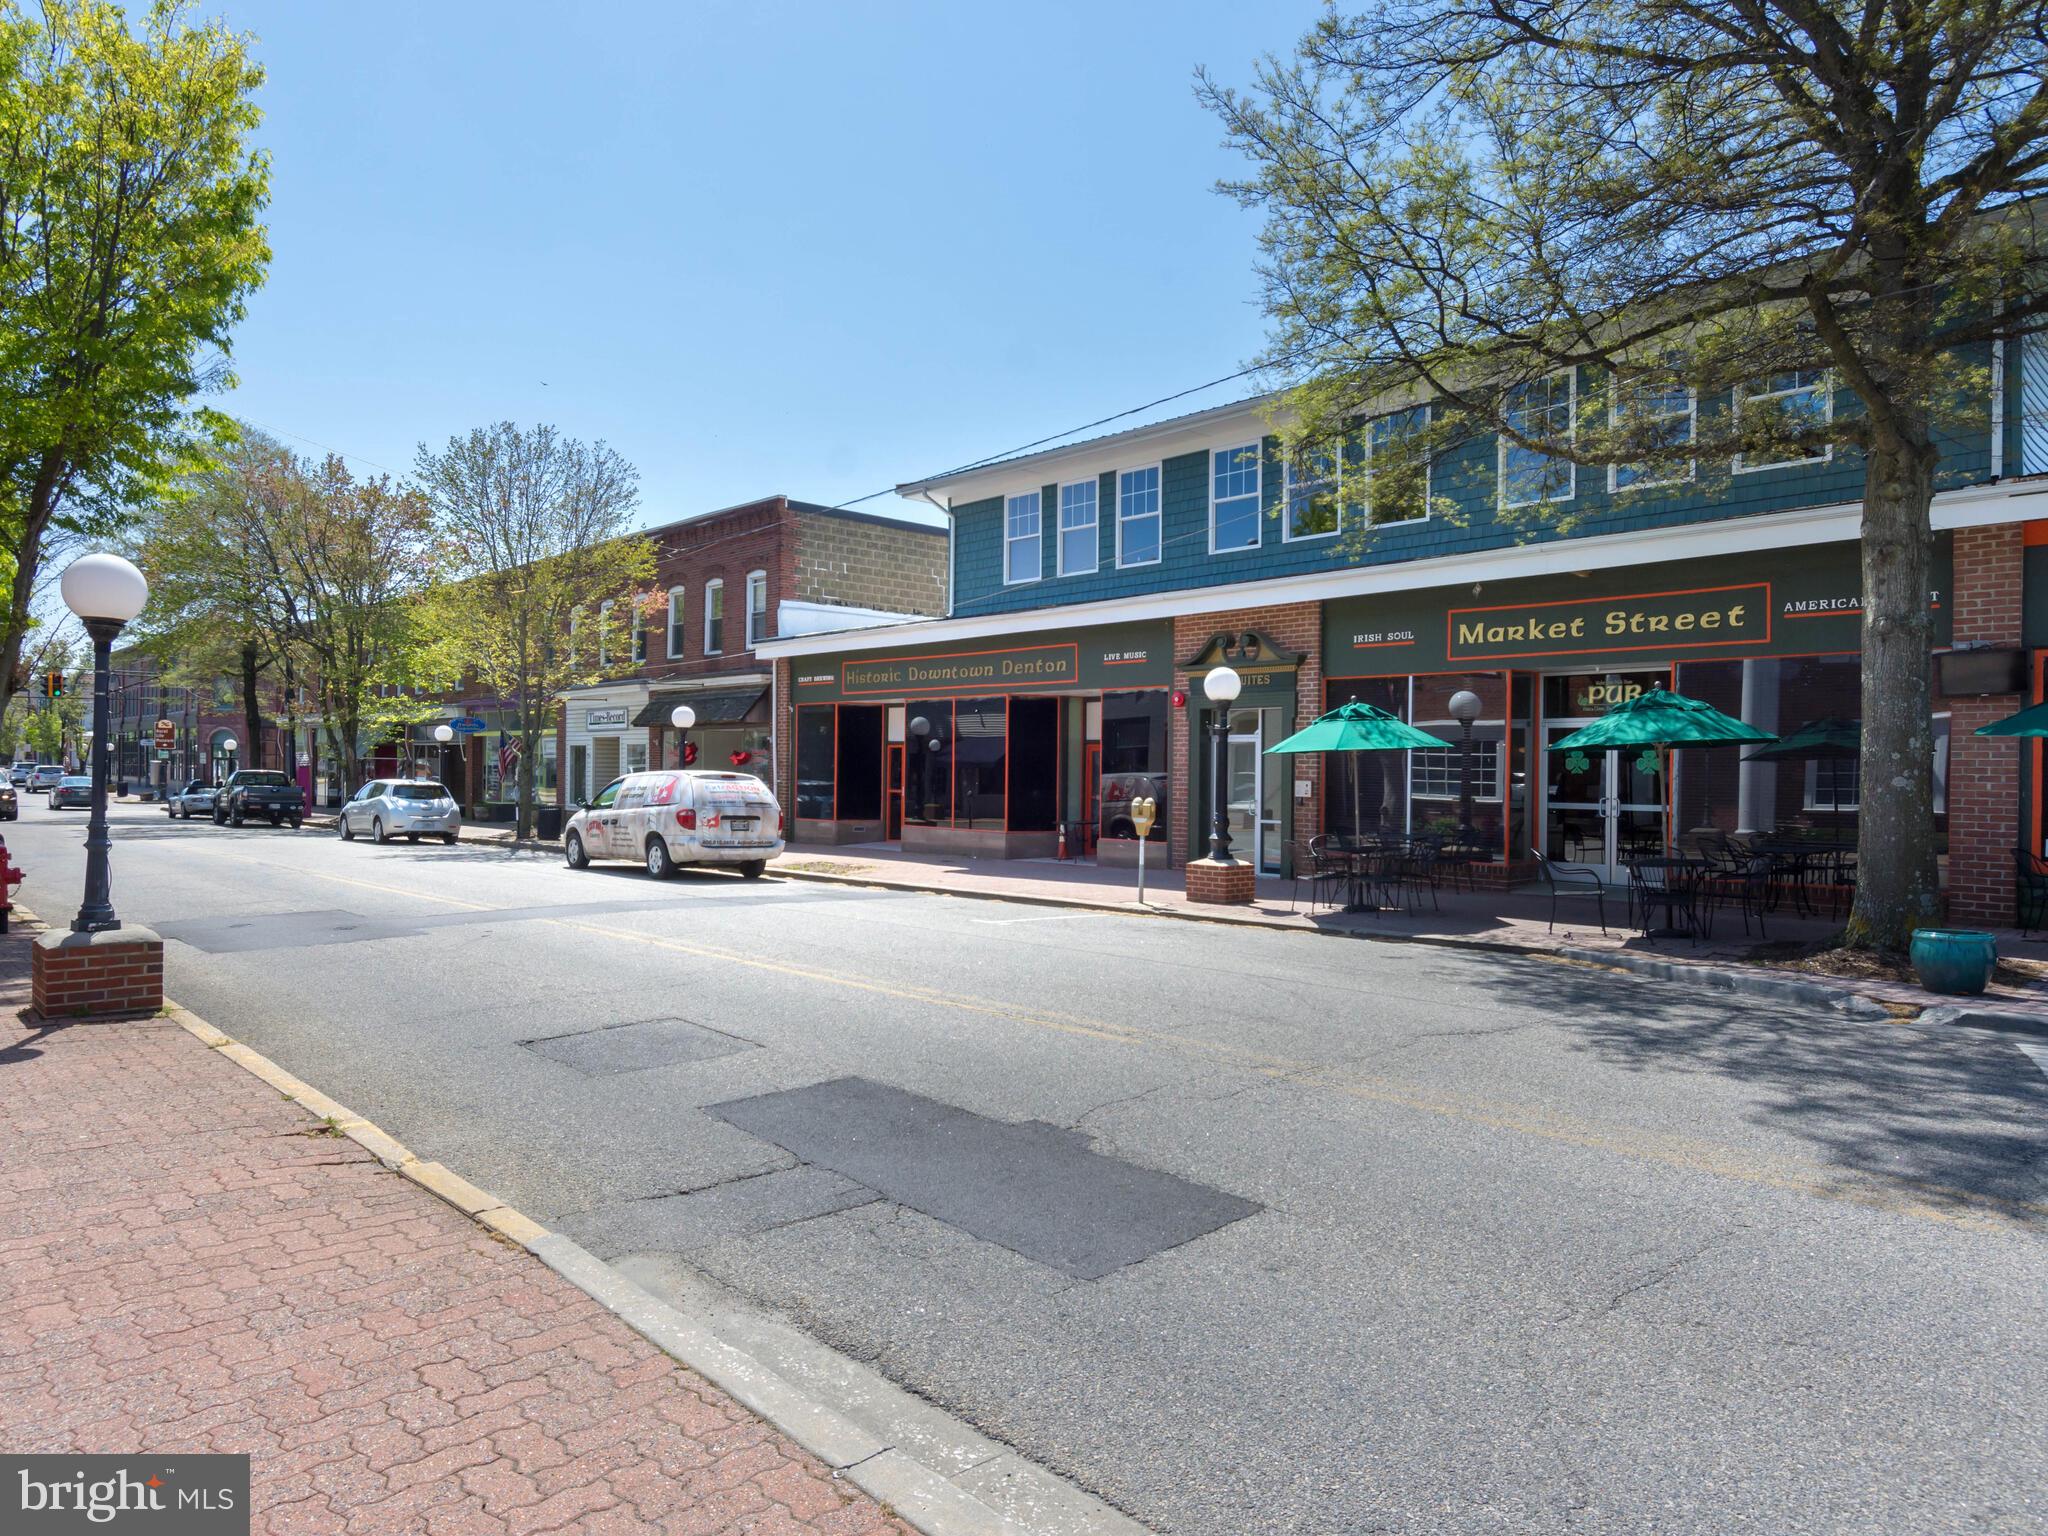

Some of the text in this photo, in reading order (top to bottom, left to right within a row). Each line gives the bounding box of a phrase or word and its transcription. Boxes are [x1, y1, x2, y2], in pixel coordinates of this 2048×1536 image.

[1784, 597, 1865, 612] AMERICA
[1459, 606, 1745, 644] Market Street
[1353, 631, 1415, 643] IRISH SOUL
[1103, 651, 1147, 661] LIVE MUSIC
[846, 659, 1067, 685] Historic Downtown Denton
[1241, 674, 1272, 686] UITES
[1587, 683, 1643, 705] PUB
